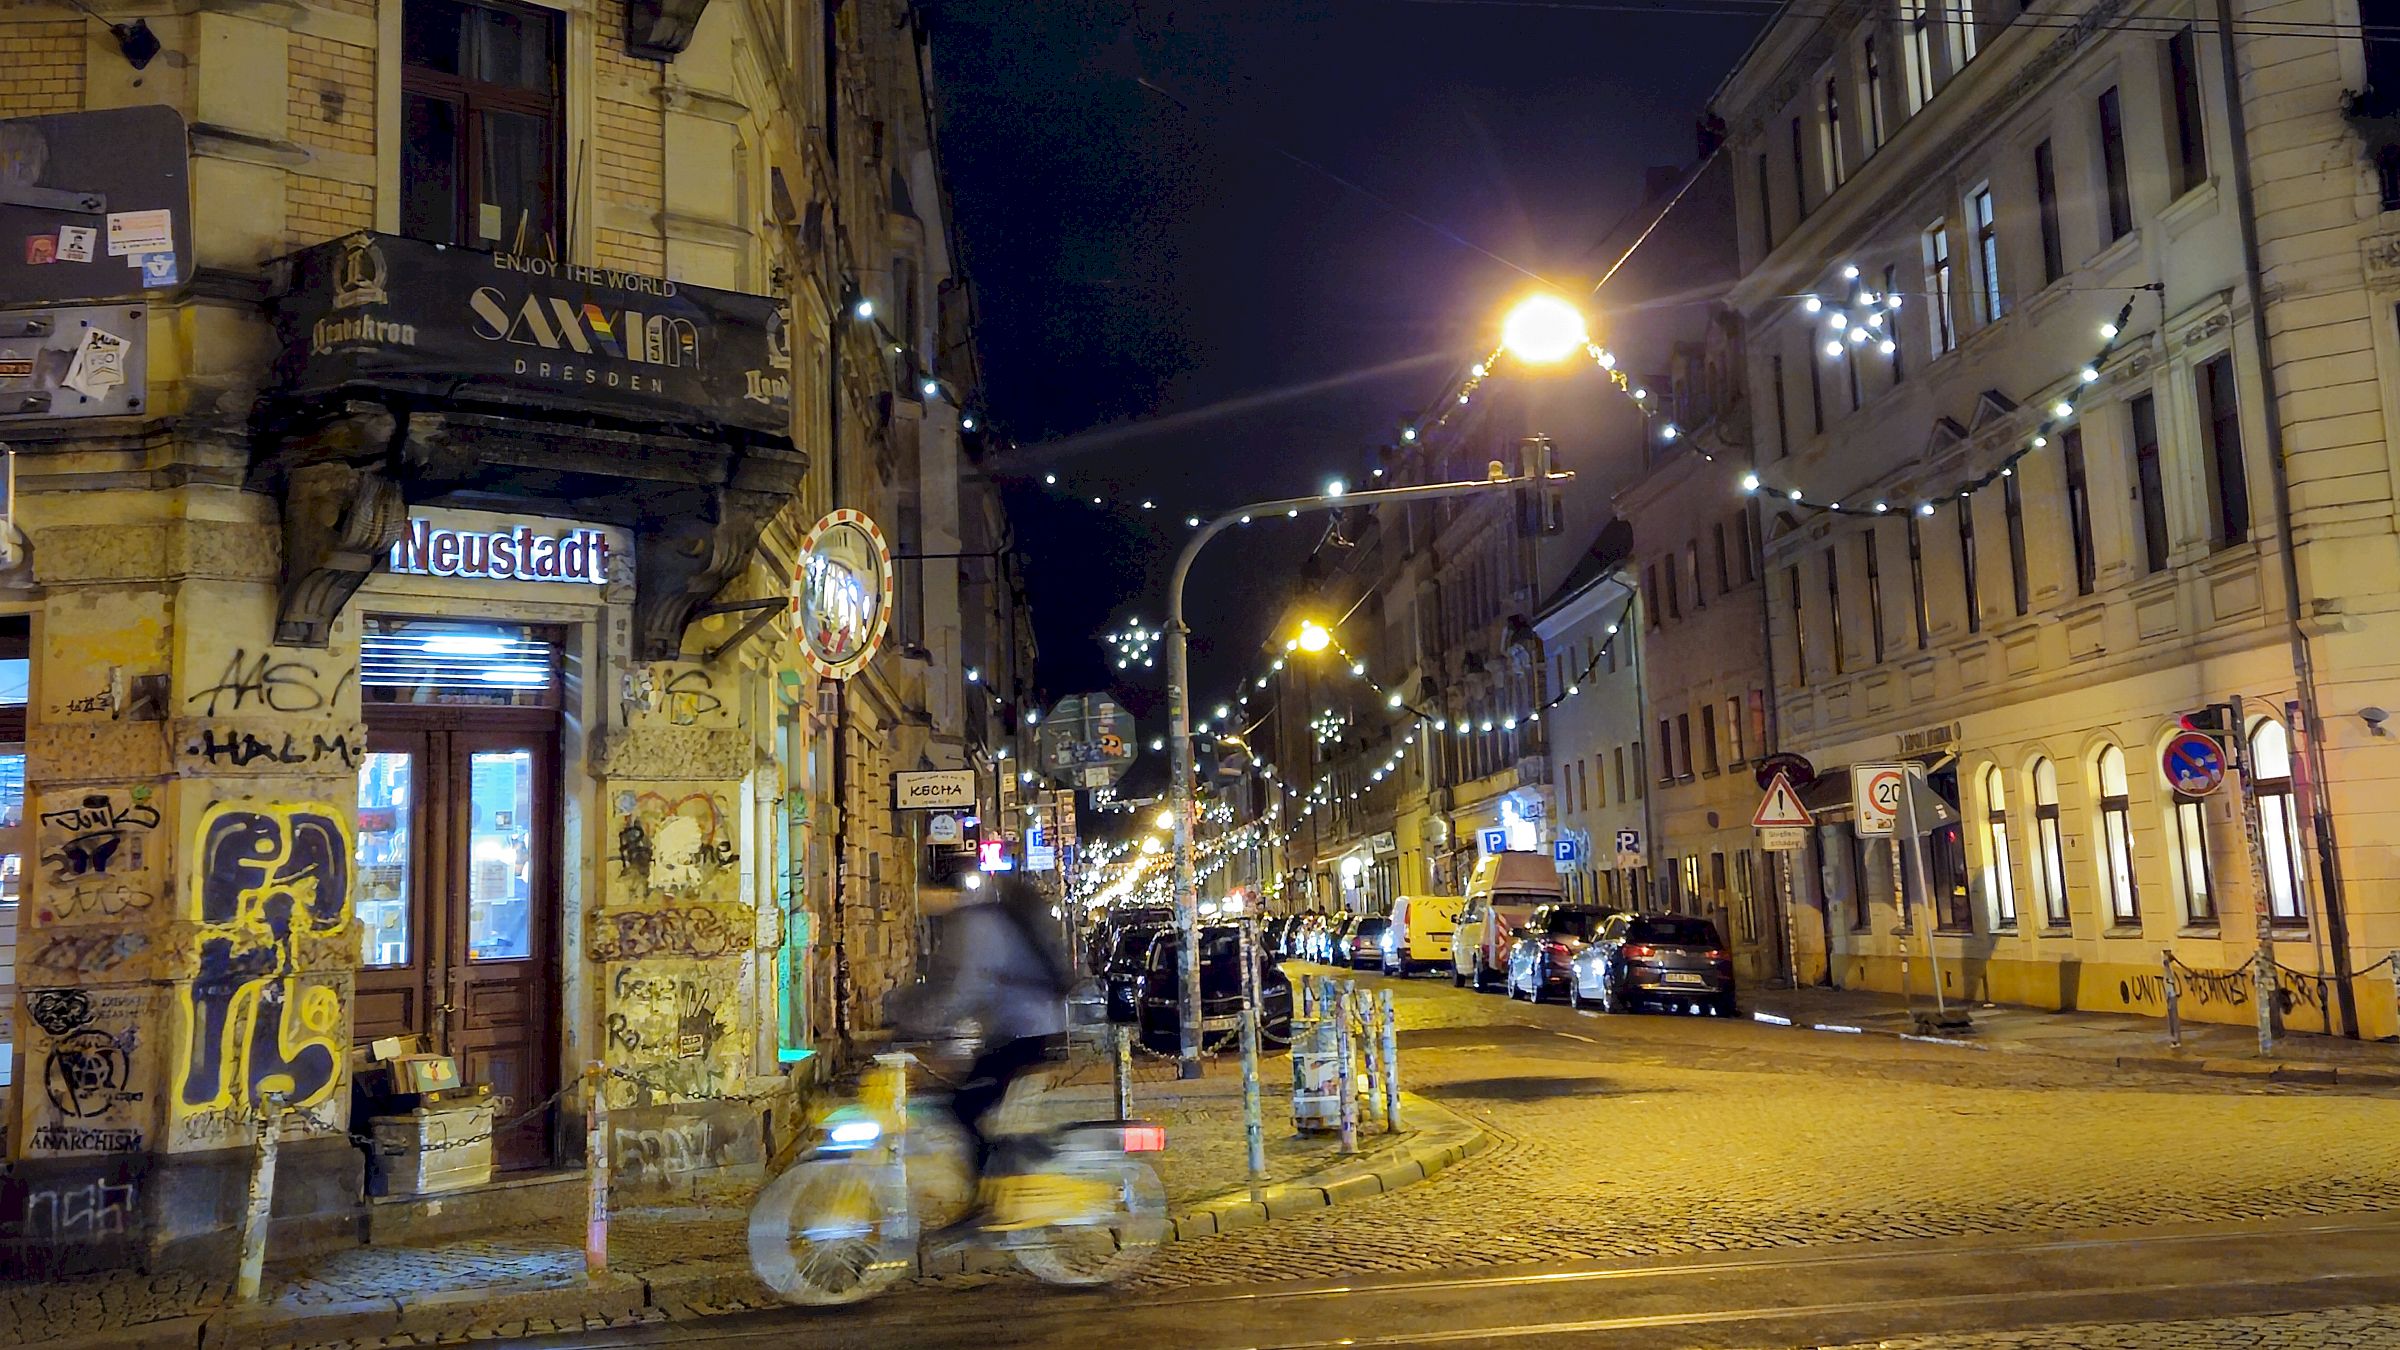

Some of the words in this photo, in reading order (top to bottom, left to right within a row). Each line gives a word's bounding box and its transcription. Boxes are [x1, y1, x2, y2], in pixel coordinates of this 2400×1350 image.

[494, 252, 558, 277] ENJOY
[566, 265, 601, 286] THE
[607, 272, 677, 298] WORLD
[515, 359, 662, 393] DRESDEN
[396, 517, 609, 582] Neustadt
[910, 784, 962, 797] KECHA
